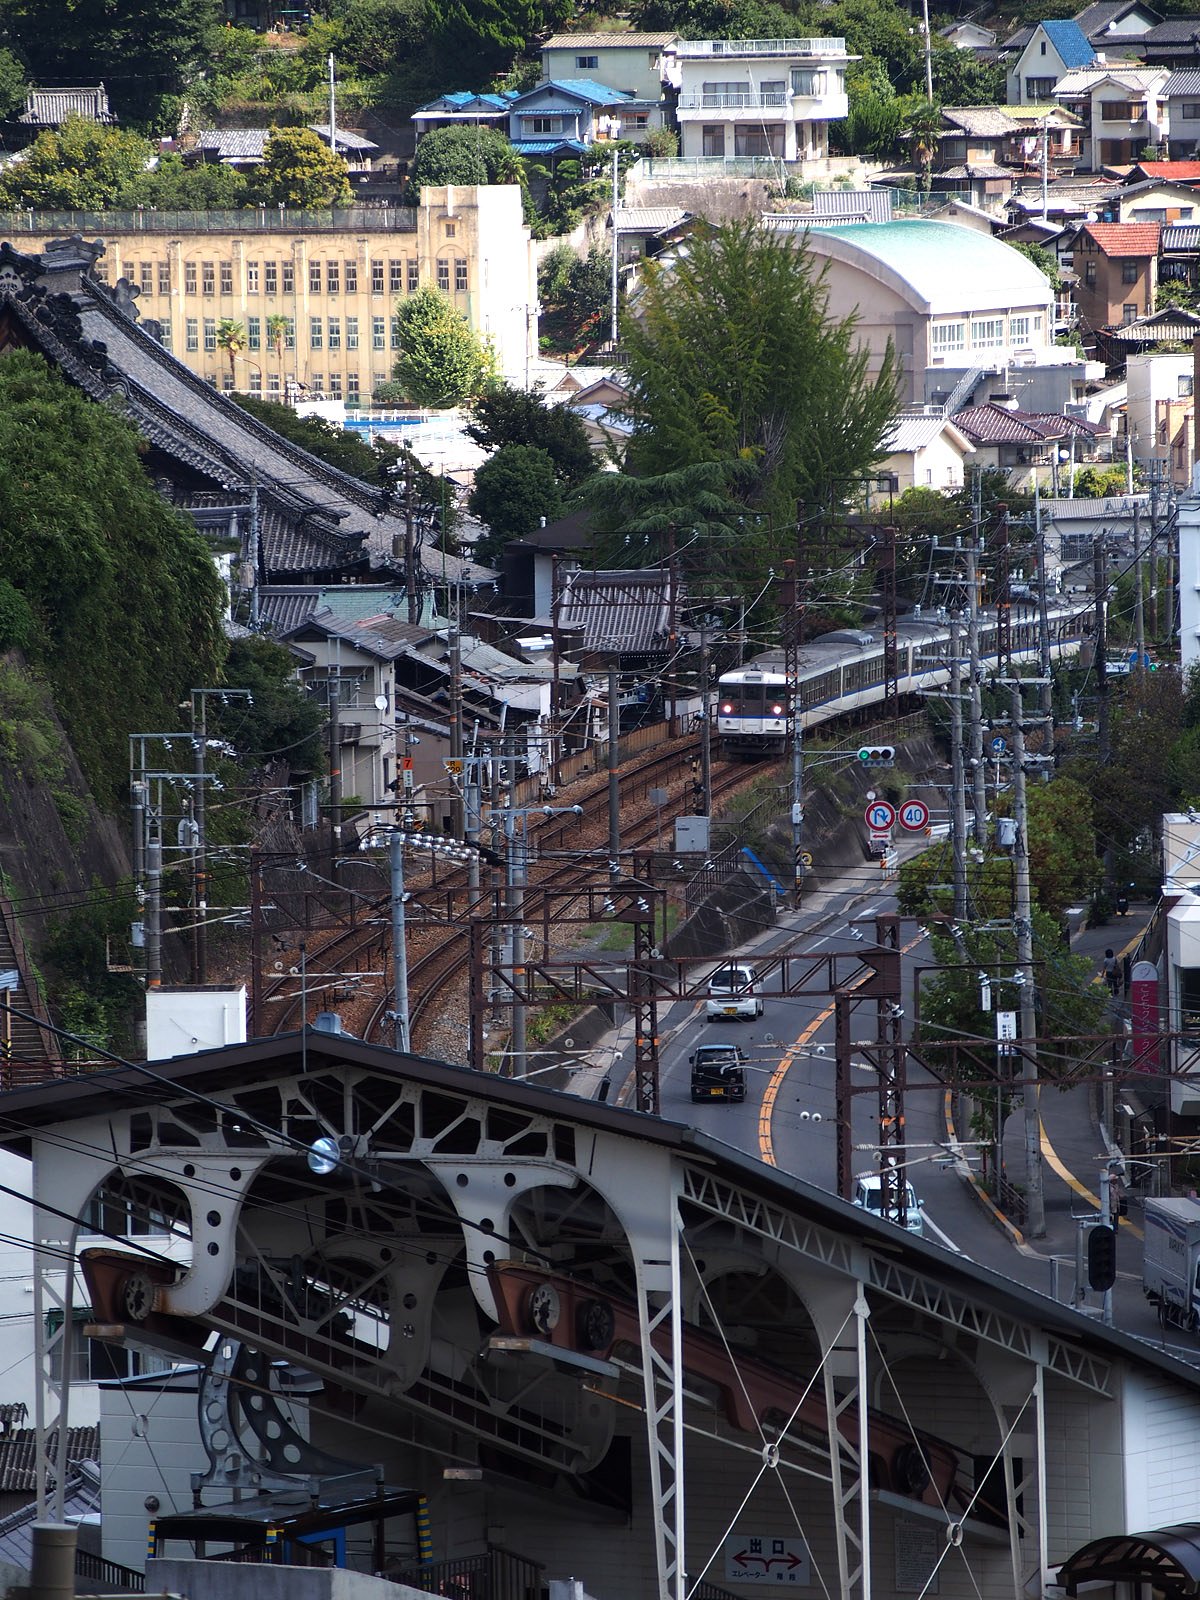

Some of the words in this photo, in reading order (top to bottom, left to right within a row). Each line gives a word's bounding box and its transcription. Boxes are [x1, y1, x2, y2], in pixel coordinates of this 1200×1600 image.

[404, 759, 411, 768] 7
[906, 809, 922, 823] 40
[750, 1538, 785, 1555] 出口
[731, 1570, 766, 1579] エレベーター
